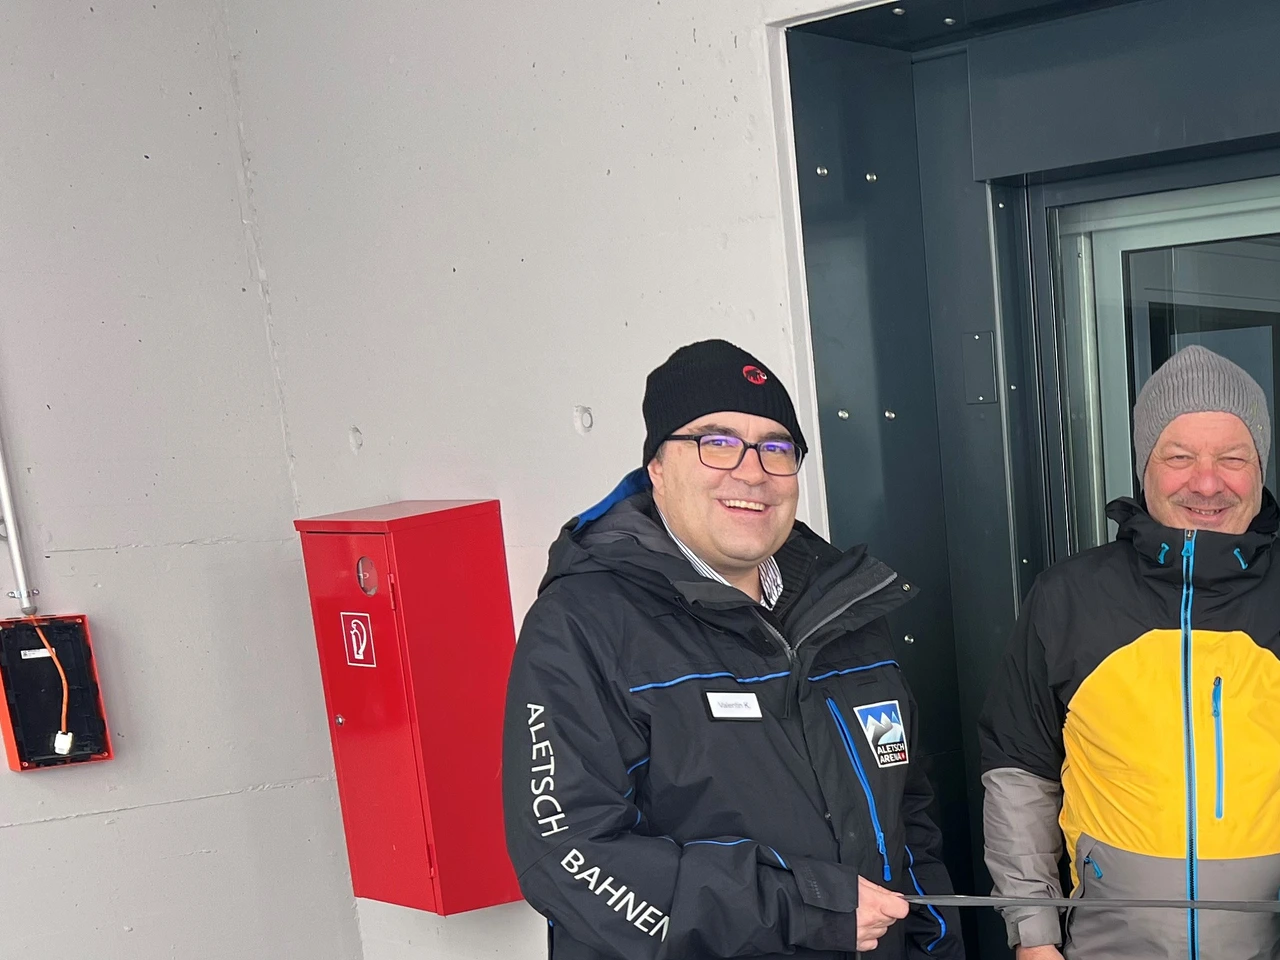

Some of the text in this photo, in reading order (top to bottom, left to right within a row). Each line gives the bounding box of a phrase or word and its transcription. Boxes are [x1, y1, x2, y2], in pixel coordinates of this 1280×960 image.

[877, 743, 905, 755] ALETSCH
[880, 752, 903, 764] ARENA
[526, 703, 570, 837] ALETSCH
